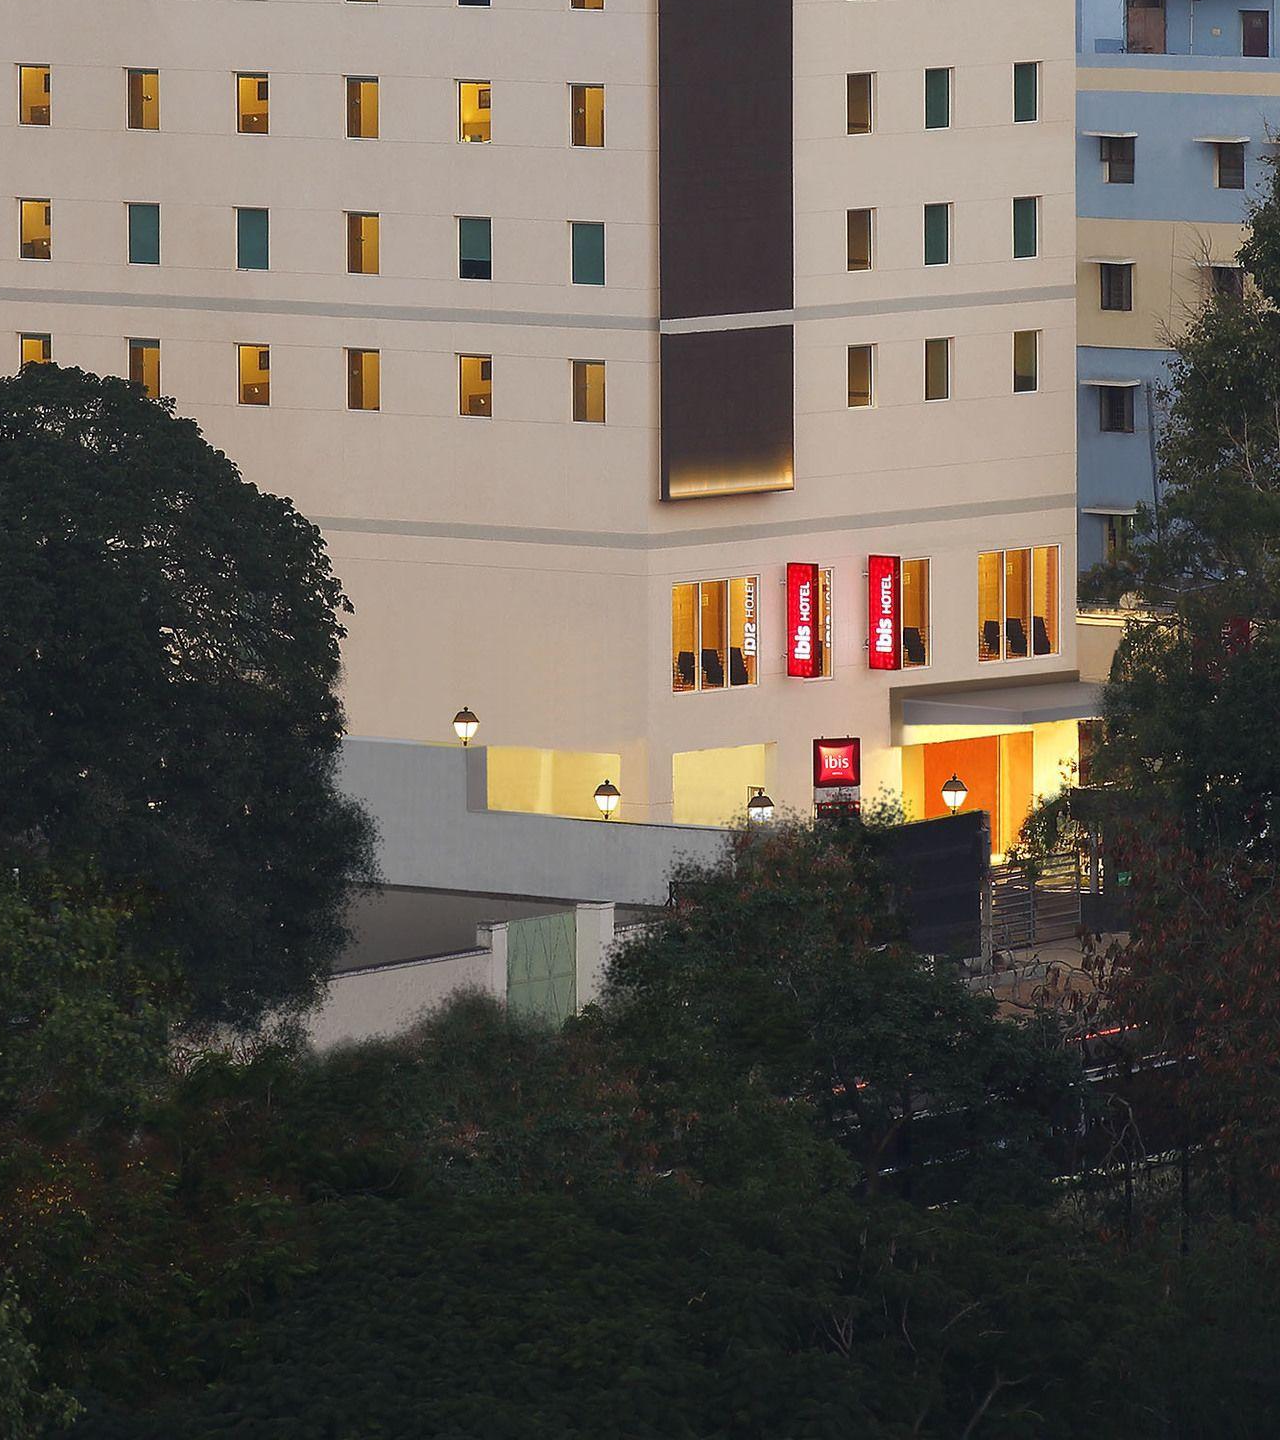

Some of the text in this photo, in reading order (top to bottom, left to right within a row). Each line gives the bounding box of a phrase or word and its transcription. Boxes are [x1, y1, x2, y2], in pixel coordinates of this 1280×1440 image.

[794, 582, 811, 660] ibis HOTEL
[876, 574, 892, 653] ibis HOTEL
[824, 755, 849, 769] ibis
